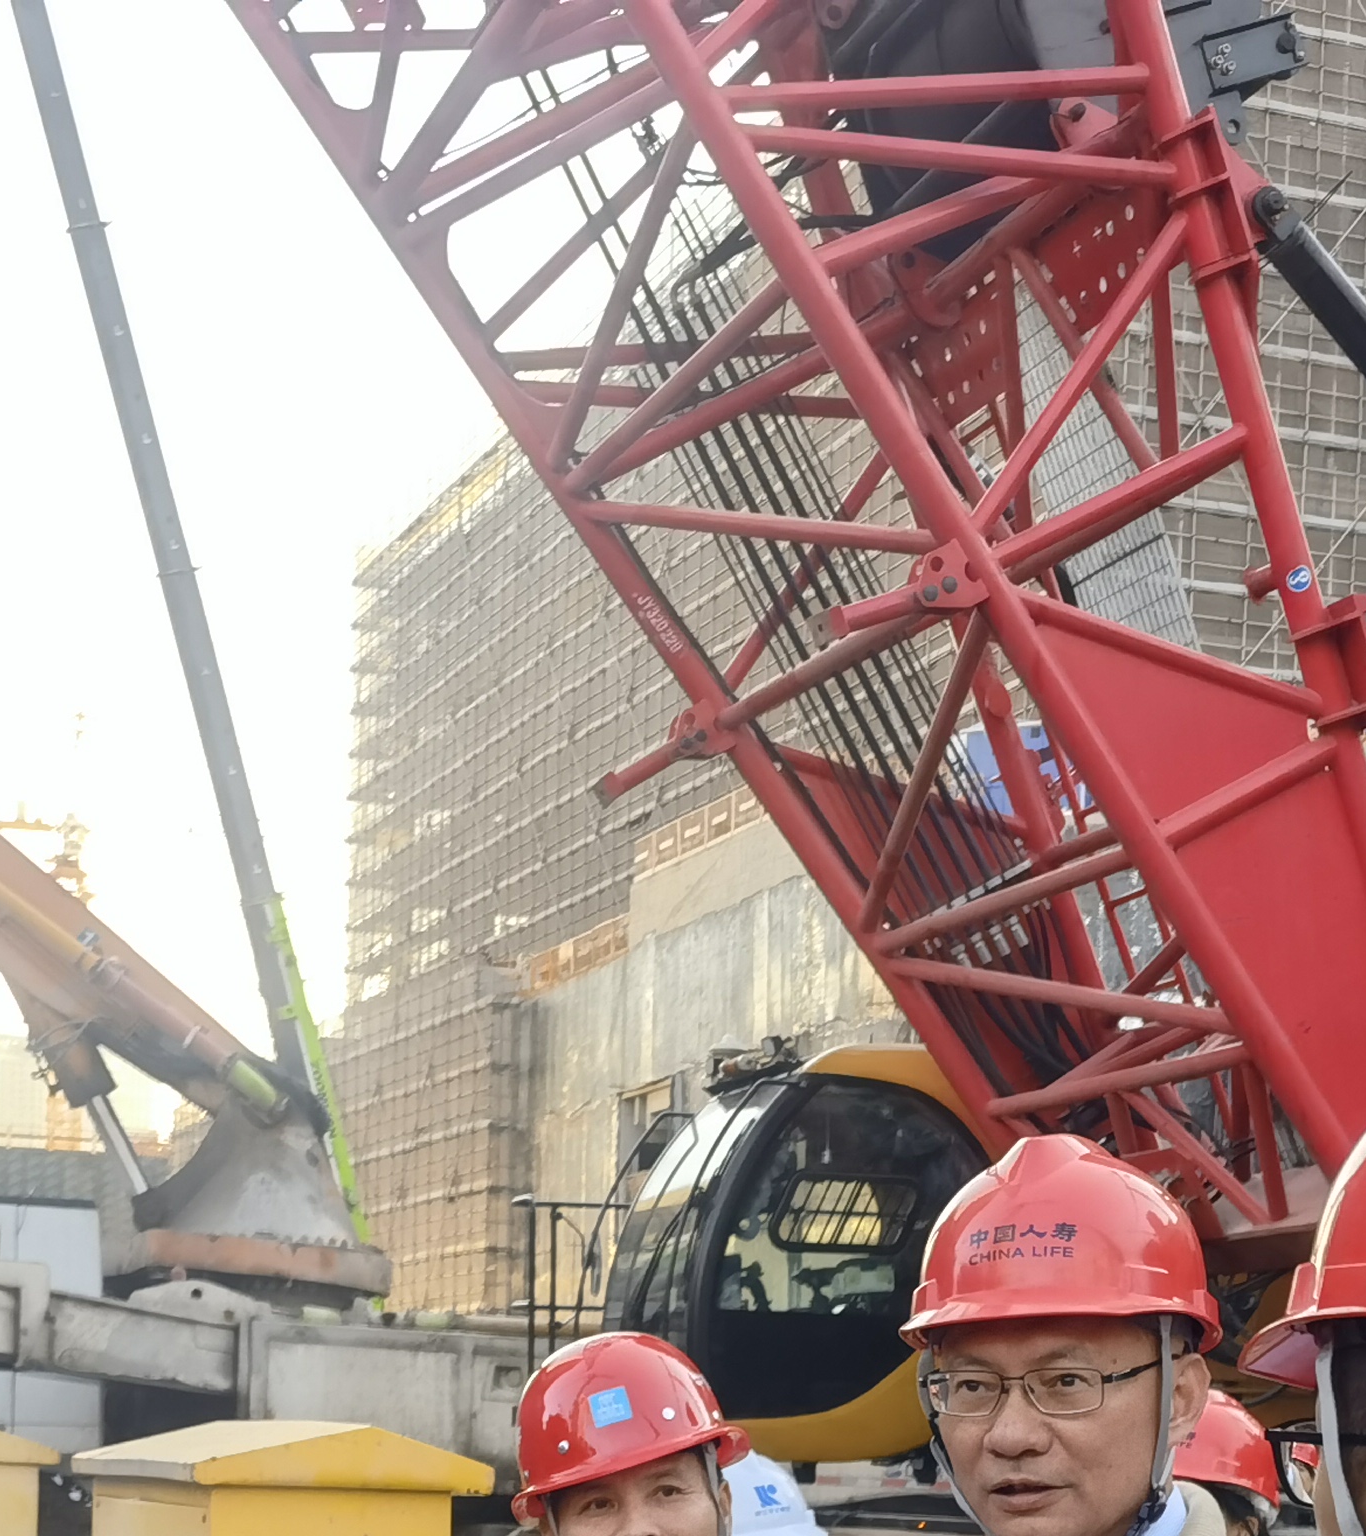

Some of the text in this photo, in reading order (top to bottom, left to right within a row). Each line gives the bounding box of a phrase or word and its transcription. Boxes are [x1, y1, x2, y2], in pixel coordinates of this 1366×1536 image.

[968, 1222, 1078, 1249] 中国人寿
[968, 1246, 1074, 1266] CHINA LIFE
